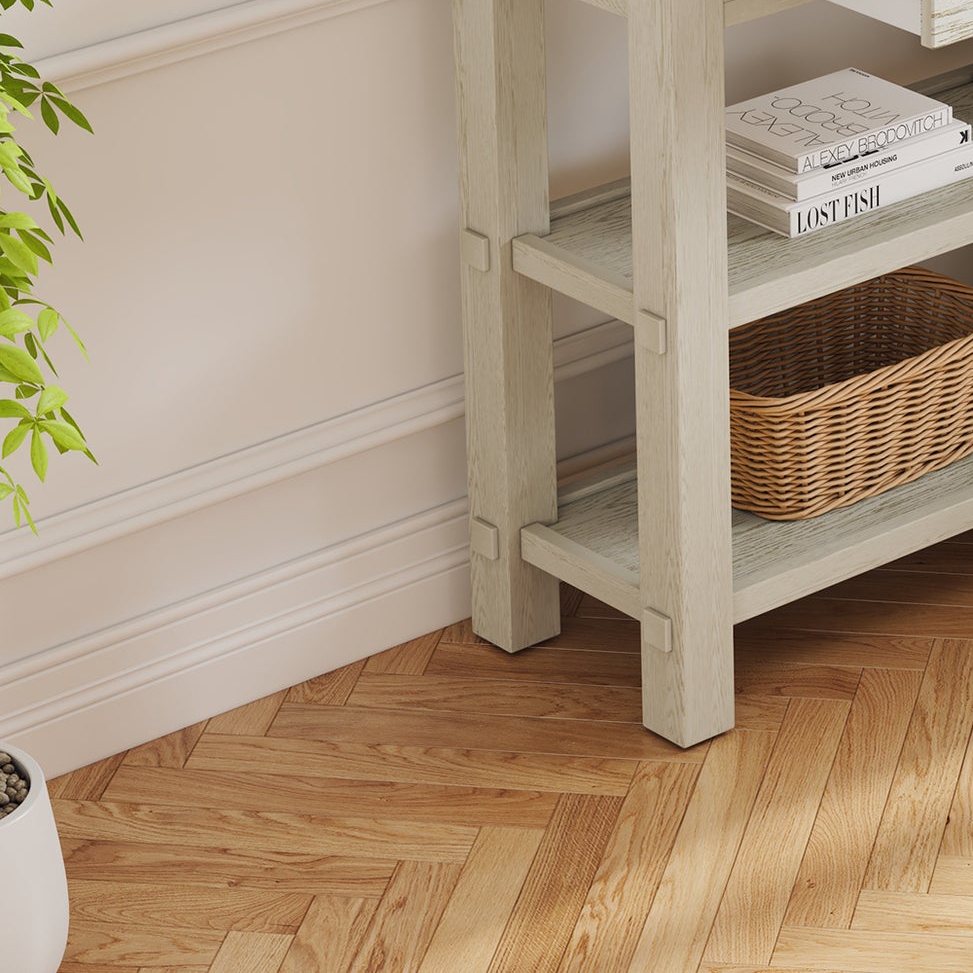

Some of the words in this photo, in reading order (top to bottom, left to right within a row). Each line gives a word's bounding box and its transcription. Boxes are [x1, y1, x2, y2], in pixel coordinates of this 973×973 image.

[802, 141, 857, 172] ALEXEY
[858, 111, 943, 154] BRODOVITCH
[831, 171, 846, 182] NEW
[847, 163, 868, 177] URBAN
[869, 154, 898, 170] HOUSING
[797, 199, 840, 234] LOST
[844, 185, 881, 218] FISH
